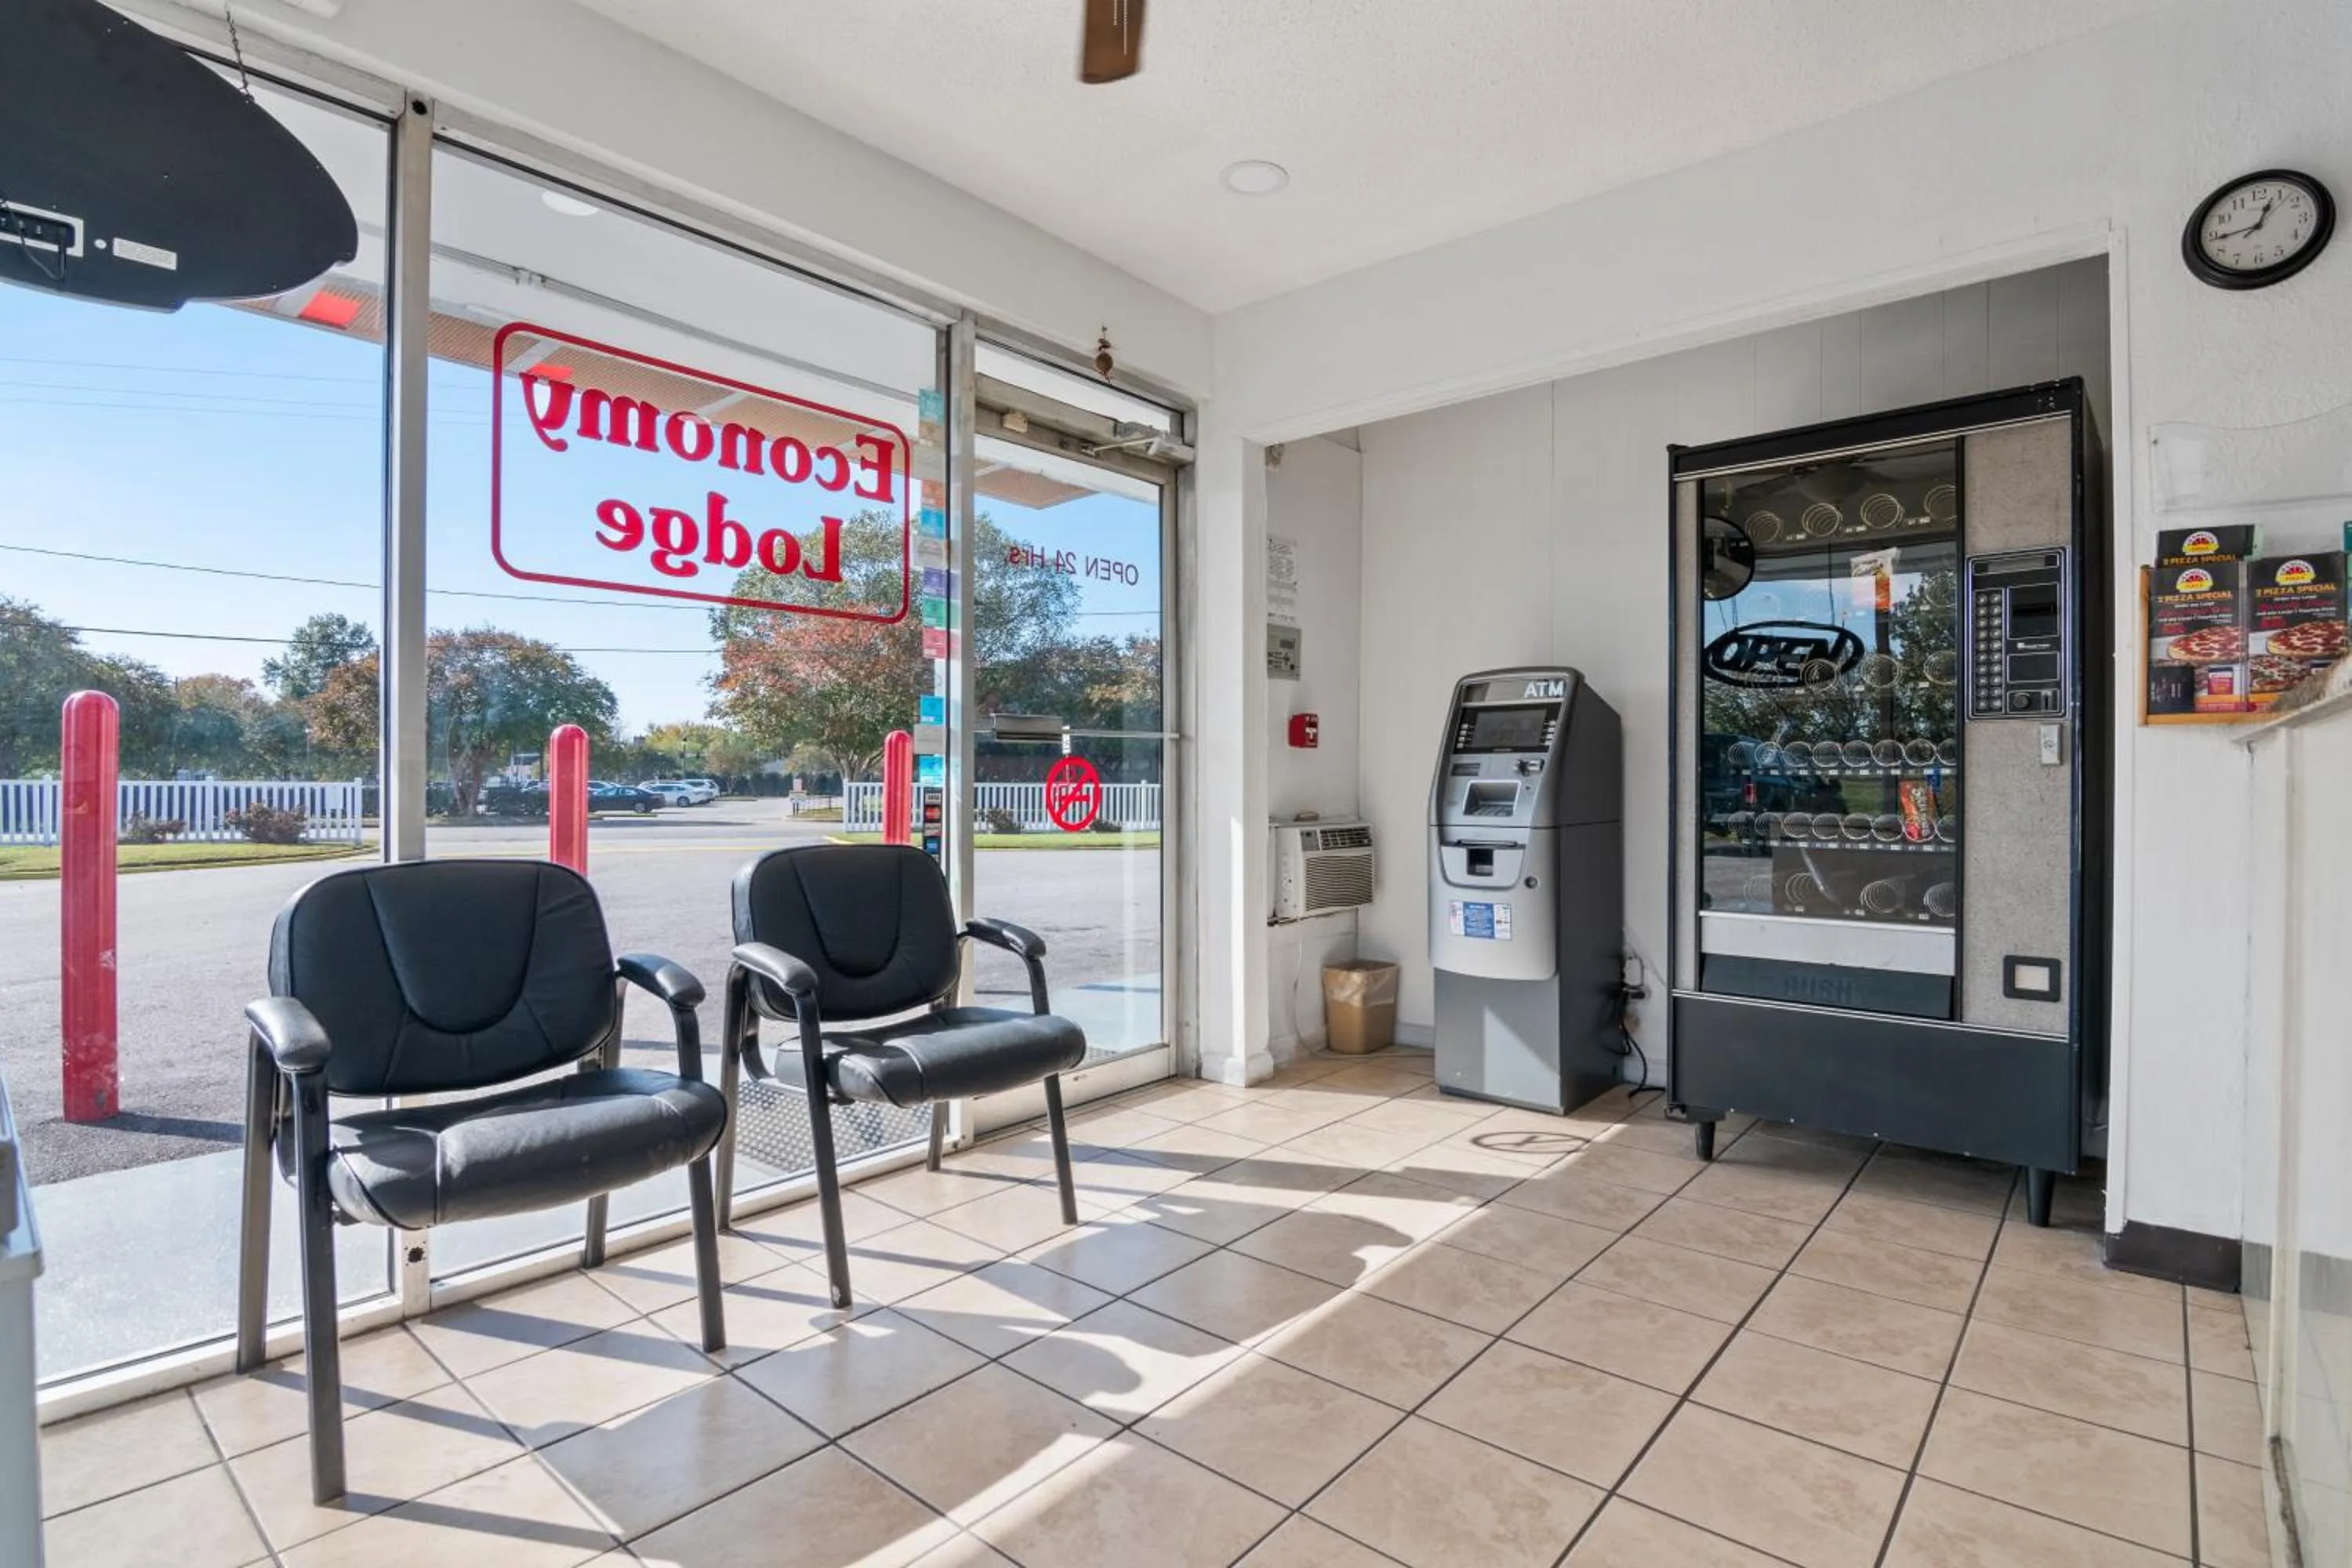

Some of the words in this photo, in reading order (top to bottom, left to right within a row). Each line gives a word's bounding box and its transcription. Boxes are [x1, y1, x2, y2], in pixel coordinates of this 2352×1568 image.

[2252, 188, 2267, 201] 12
[2278, 189, 2282, 200] 1
[2233, 198, 2245, 210] 11
[2290, 196, 2299, 209] 2
[2218, 213, 2231, 224] 10
[2298, 212, 2307, 224] 3
[2169, 556, 2199, 564] PIZZA
[2201, 554, 2236, 562] SPECIAL
[2263, 586, 2295, 596] PIZZA
[2296, 583, 2336, 592] SPECIAL
[2164, 593, 2194, 602] PIZZA
[2194, 590, 2234, 600] SPECIAL
[1523, 681, 1564, 698] ATM
